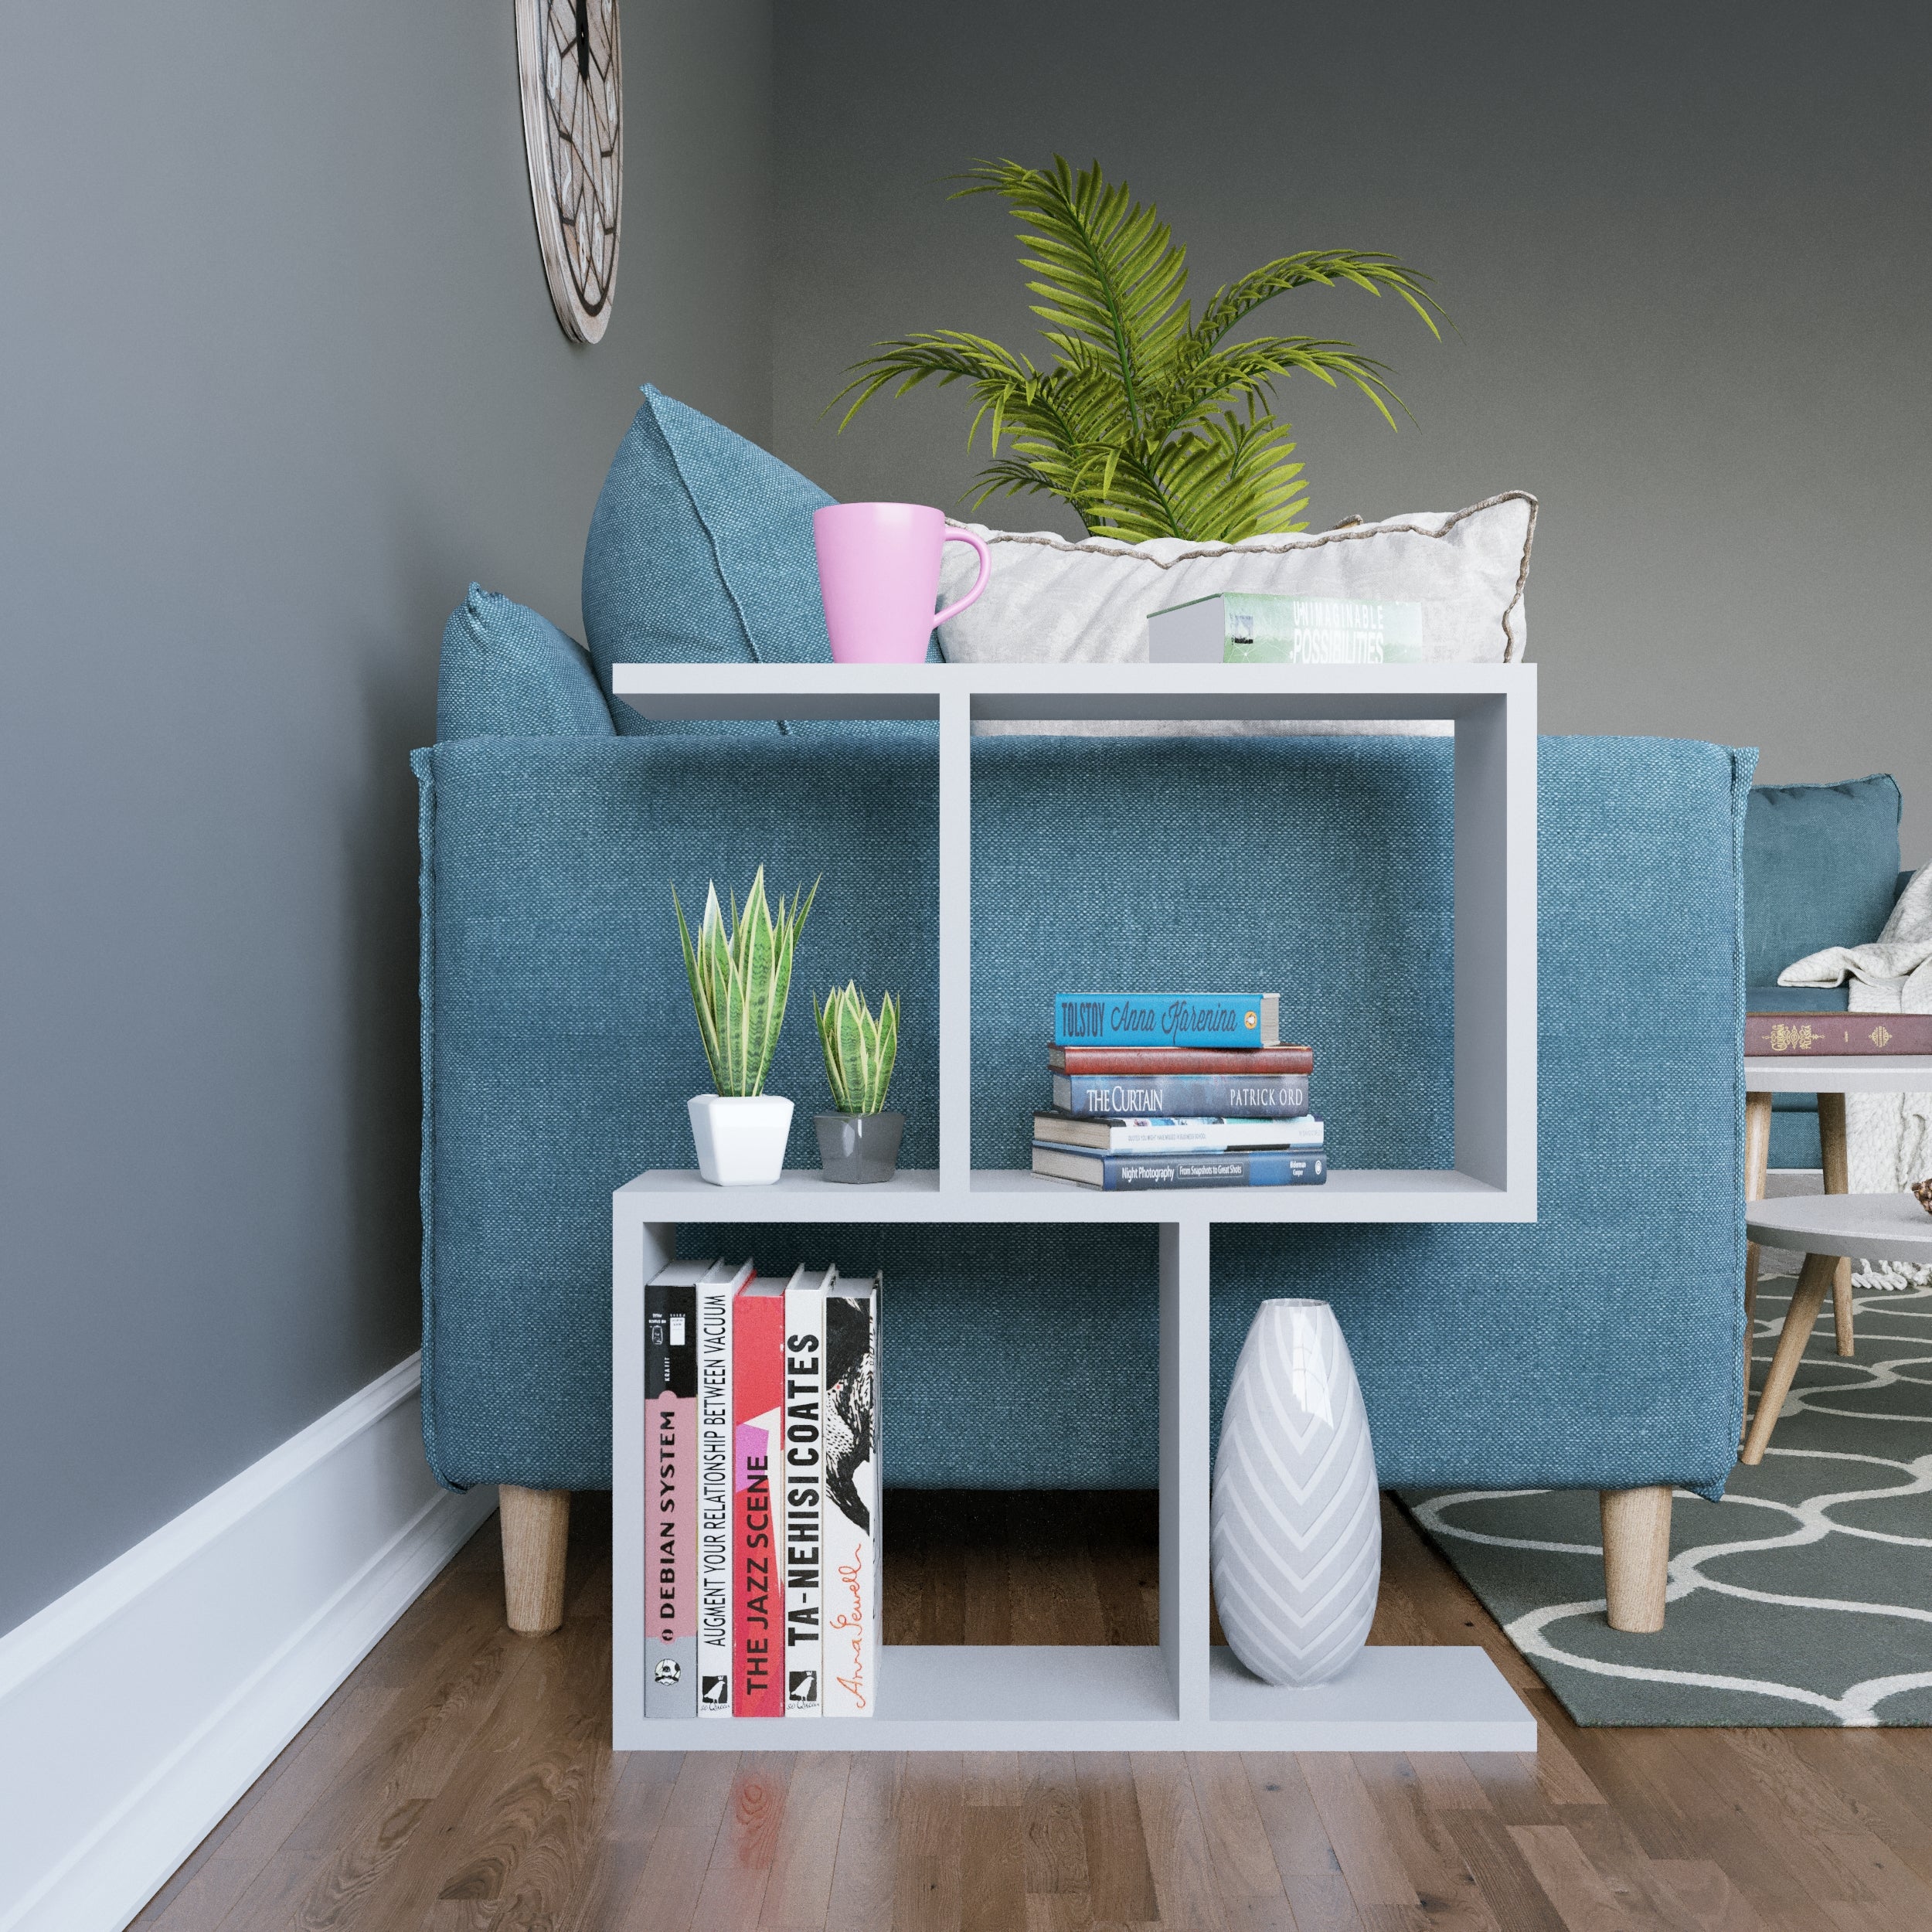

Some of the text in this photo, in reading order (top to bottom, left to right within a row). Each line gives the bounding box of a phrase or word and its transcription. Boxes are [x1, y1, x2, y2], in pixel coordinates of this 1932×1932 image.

[1293, 600, 1383, 630] UNIMAGINABLE
[1293, 628, 1384, 664] POSSIBILITIES
[1061, 1000, 1238, 1045] TOLSTOY Anna Karenina
[1087, 1086, 1163, 1112] THE CURTAIN
[1230, 1088, 1303, 1106] PATRICK ORD
[1121, 1165, 1175, 1182] Night Photography
[1179, 1164, 1242, 1176] From Snapshots to Great Shots
[703, 1294, 726, 1647] AUGMENT YOUR RELATIONSHIP BETWEEN VACUUM
[787, 1334, 819, 1647] TA-NEHISI COATES
[660, 1411, 675, 1619] DEBIAN SYSTEM
[747, 1455, 769, 1696] THE JAZZ SCENE
